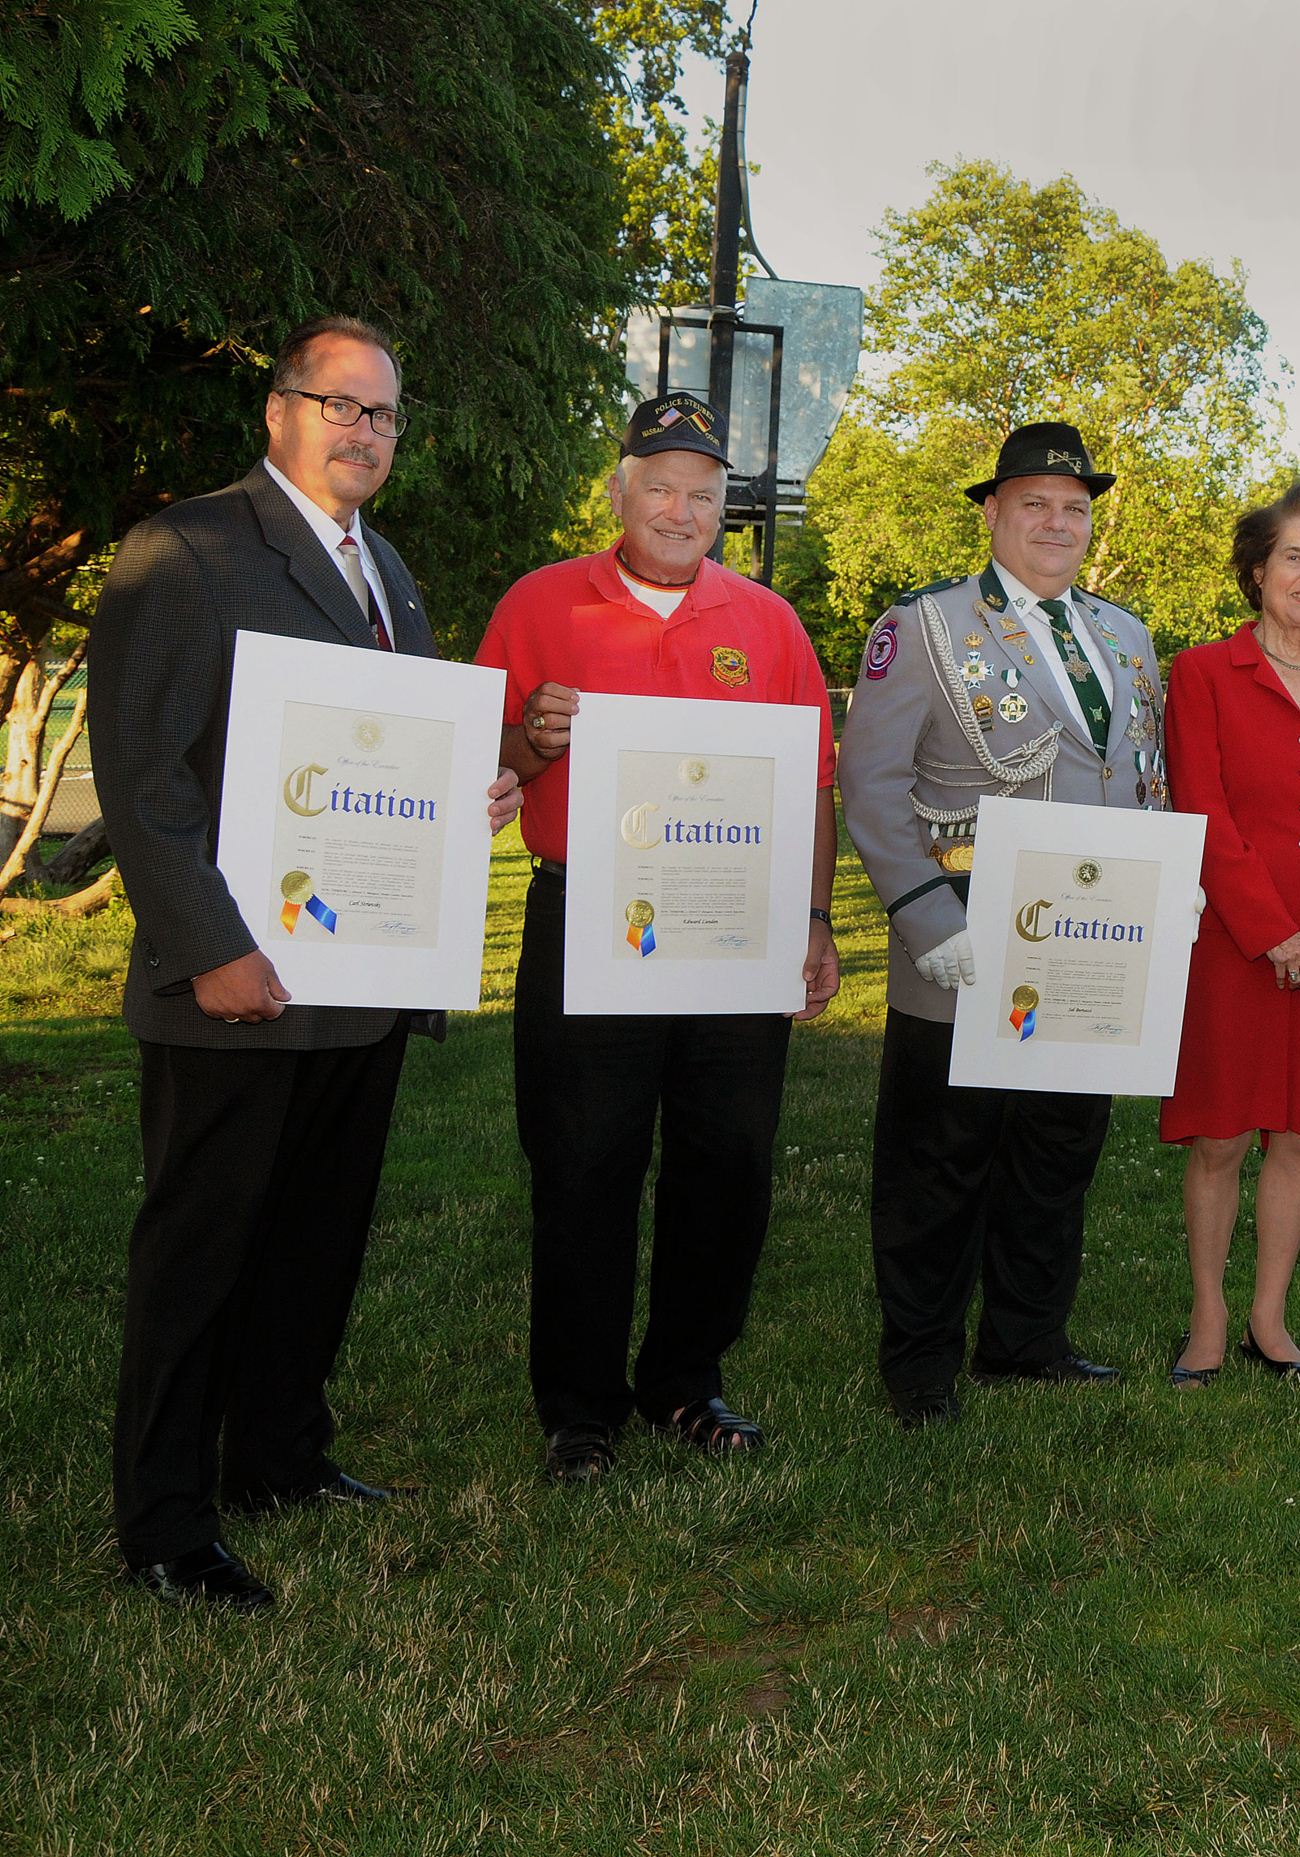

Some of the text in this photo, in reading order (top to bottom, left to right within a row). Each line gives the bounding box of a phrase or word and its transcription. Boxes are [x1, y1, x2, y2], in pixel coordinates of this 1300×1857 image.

[641, 426, 665, 438] NASSAU
[654, 398, 716, 423] POLICE STEUBEN
[282, 762, 437, 822] Citation
[620, 801, 762, 850] Citation
[1015, 898, 1145, 944] Citation
